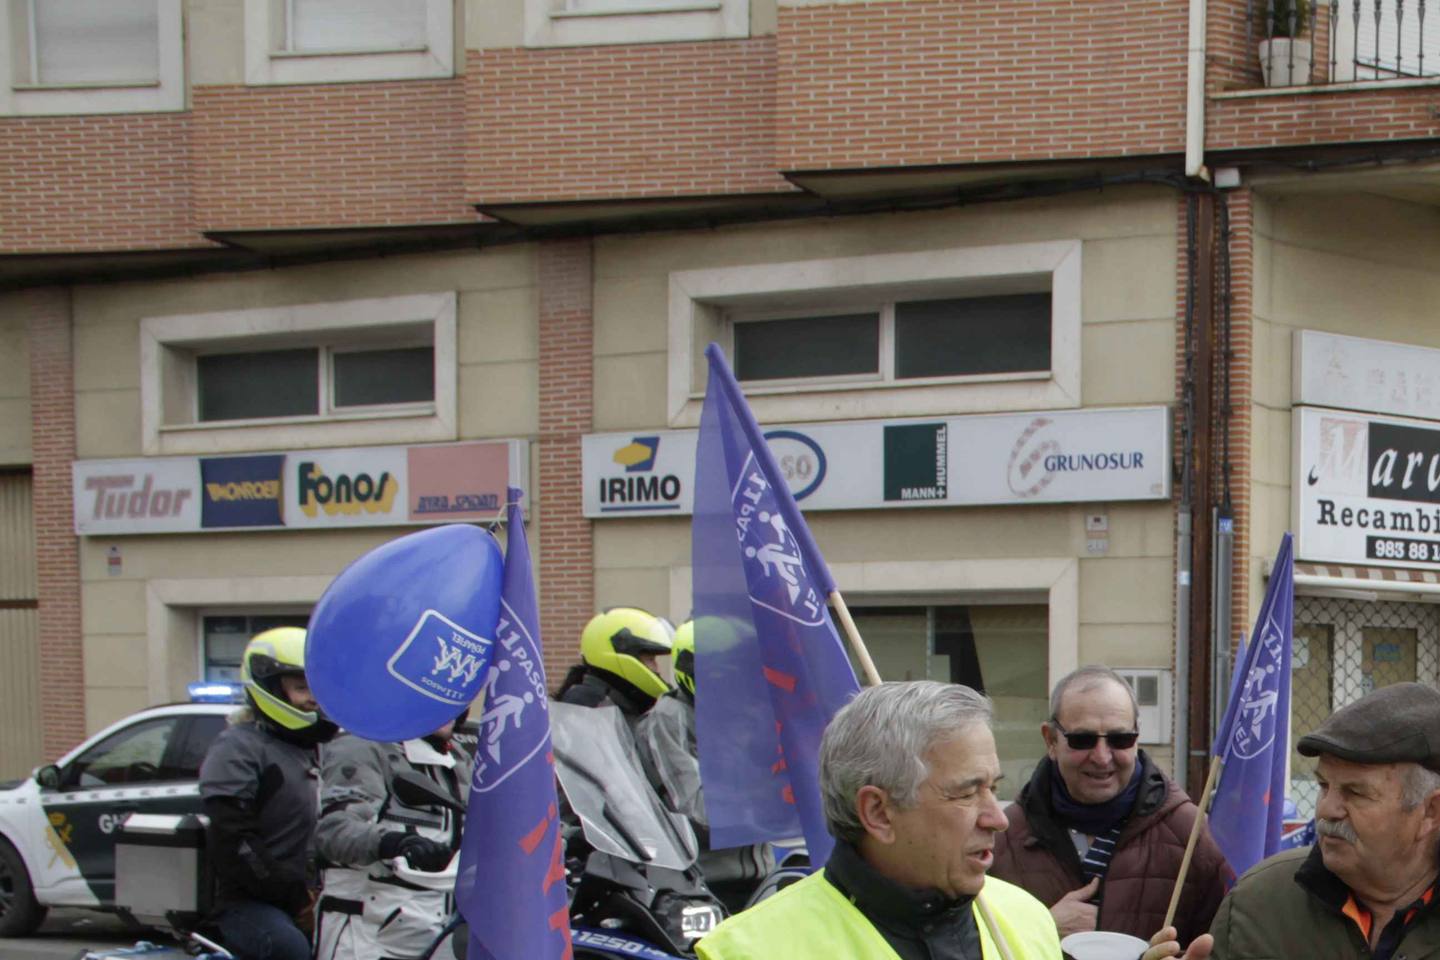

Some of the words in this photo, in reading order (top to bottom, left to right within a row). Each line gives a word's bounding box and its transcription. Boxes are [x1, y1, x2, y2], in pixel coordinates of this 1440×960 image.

[1044, 452, 1144, 472] GRUNOSUR
[85, 473, 192, 520] Tudor
[298, 461, 393, 509] Fonos
[600, 475, 681, 503] IRIMO
[1375, 540, 1405, 558] 983
[1409, 543, 1428, 560] 88
[578, 931, 644, 953] 1250
